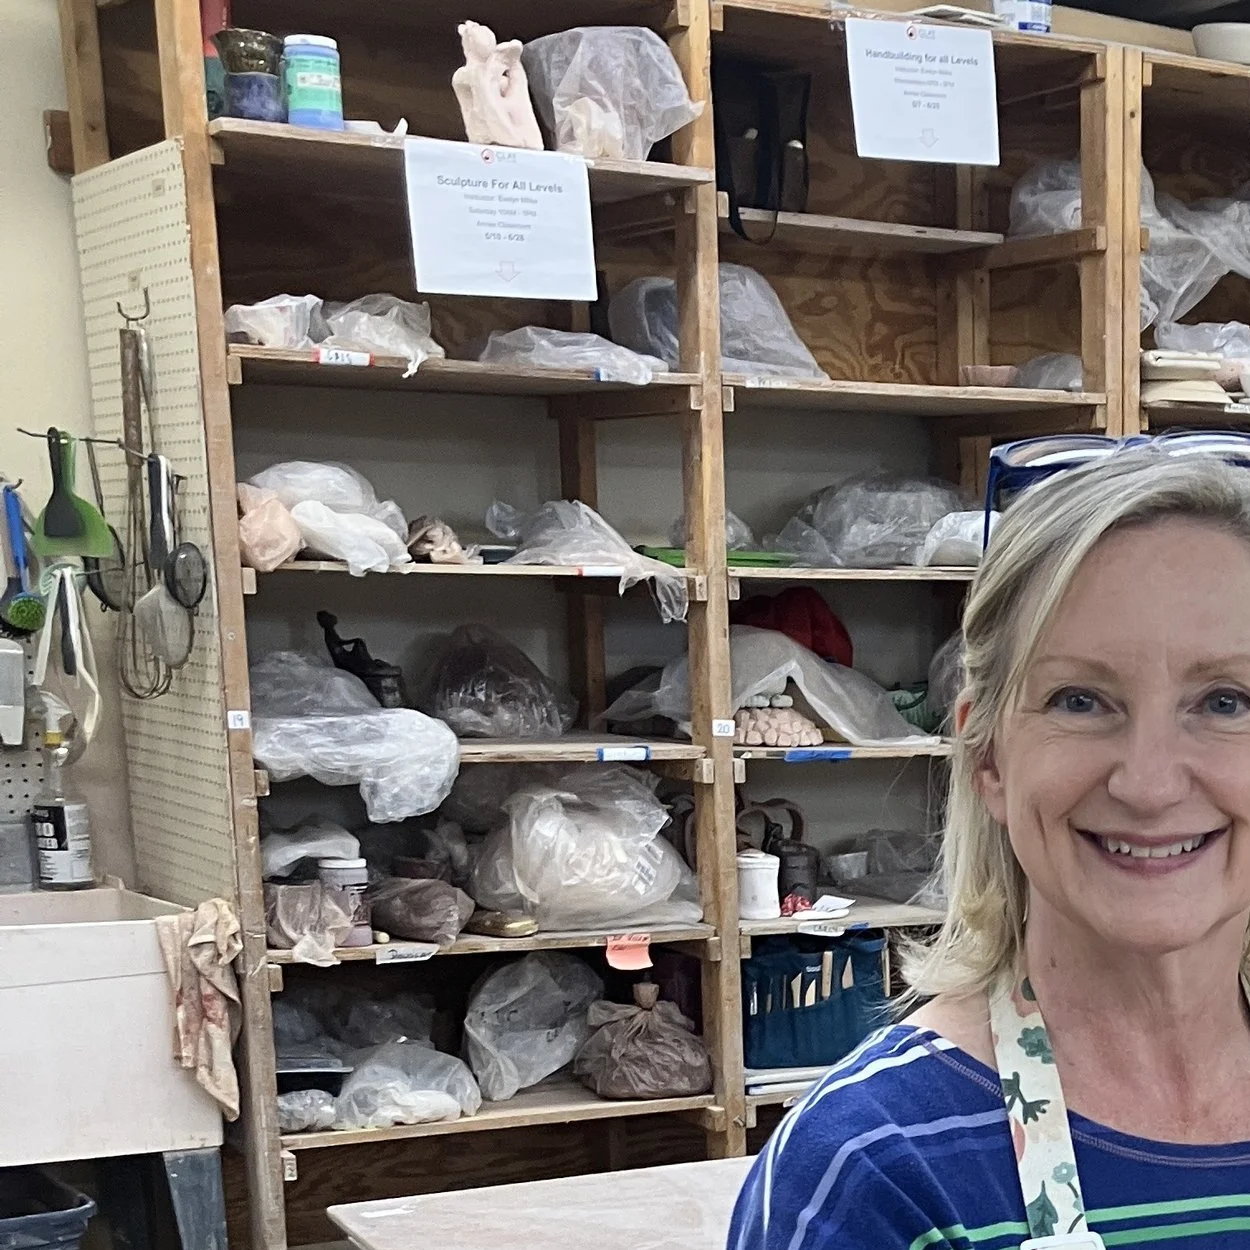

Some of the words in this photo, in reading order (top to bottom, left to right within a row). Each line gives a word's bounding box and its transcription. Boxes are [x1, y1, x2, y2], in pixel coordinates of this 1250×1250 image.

[865, 49, 922, 64] Handbuilding
[925, 53, 937, 63] for
[939, 55, 949, 64] all
[951, 55, 979, 66] Levels
[437, 175, 489, 189] Sculpture
[491, 179, 509, 190] For
[512, 180, 526, 190] All
[529, 182, 563, 194] Levels
[233, 714, 244, 727] 19
[717, 725, 730, 734] 20
